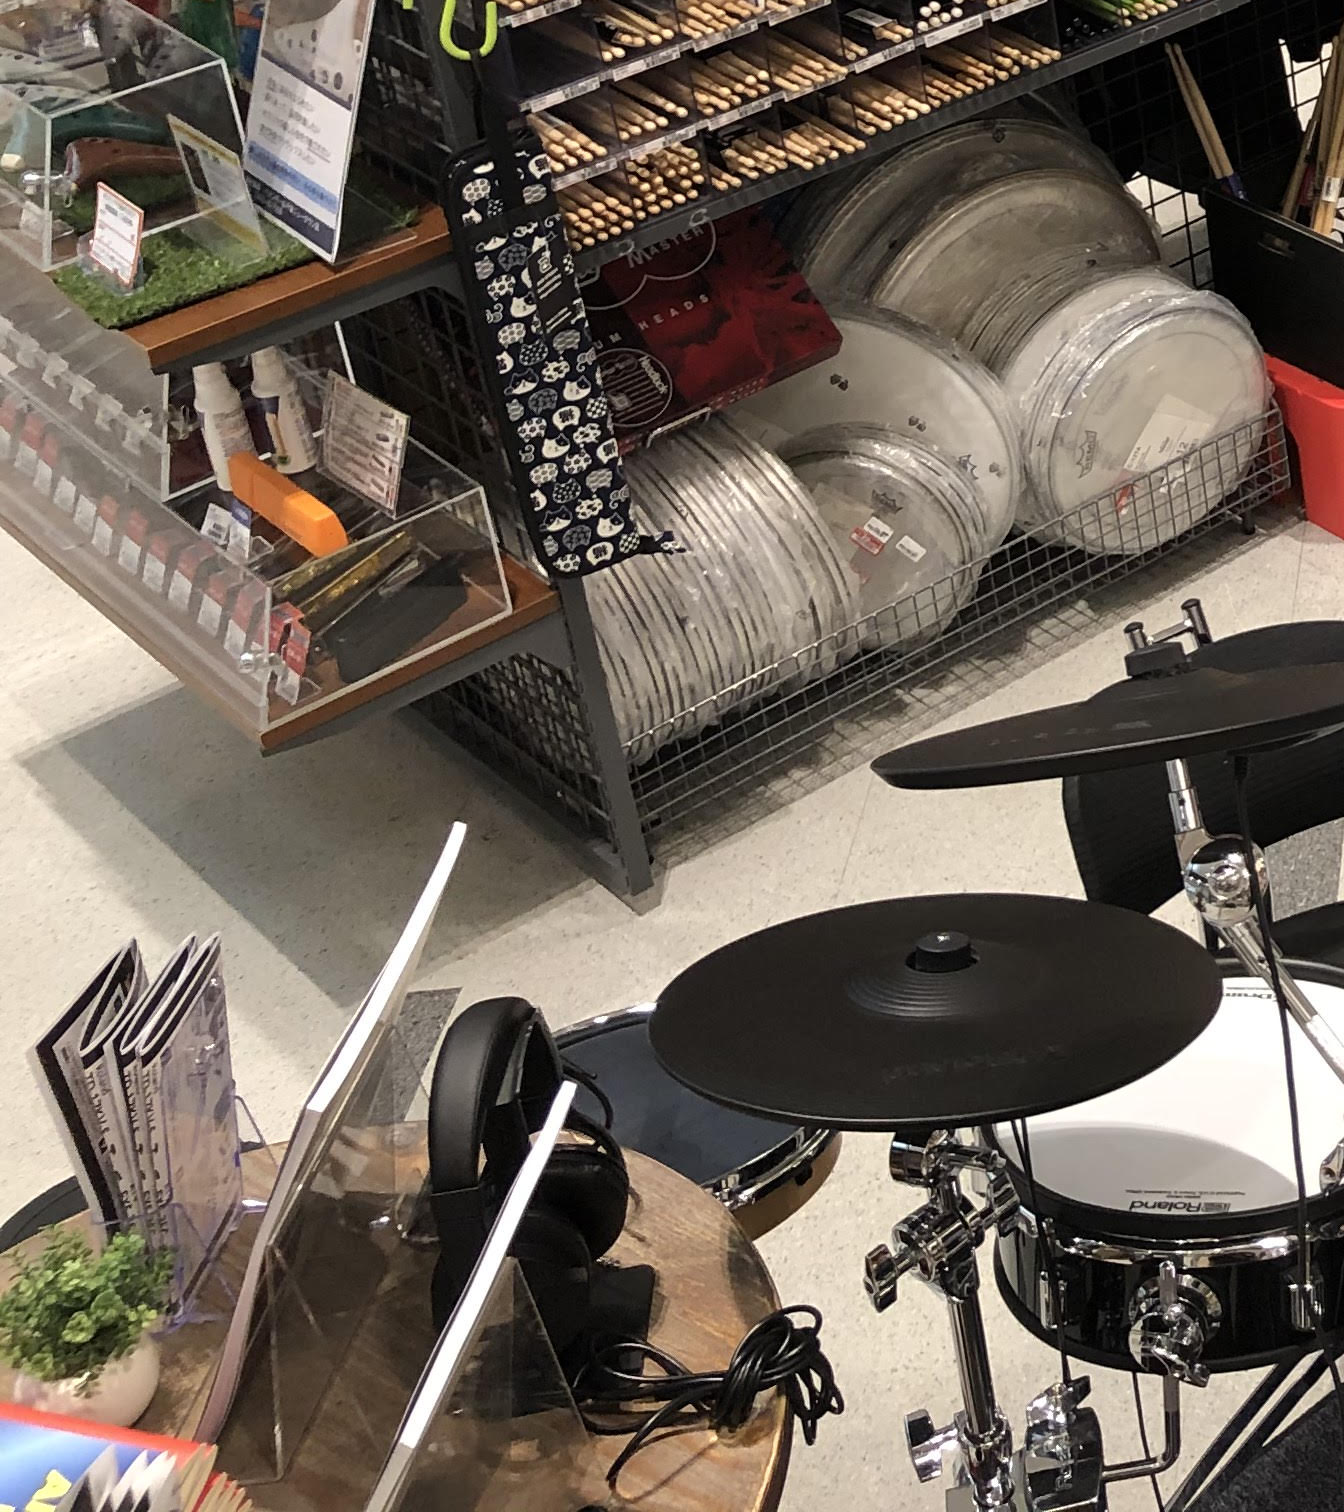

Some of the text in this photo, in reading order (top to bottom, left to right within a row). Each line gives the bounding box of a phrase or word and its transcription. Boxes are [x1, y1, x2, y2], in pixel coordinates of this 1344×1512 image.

[627, 224, 706, 270] MASTER
[638, 292, 710, 332] HEADS
[1128, 1198, 1204, 1215] Roland
